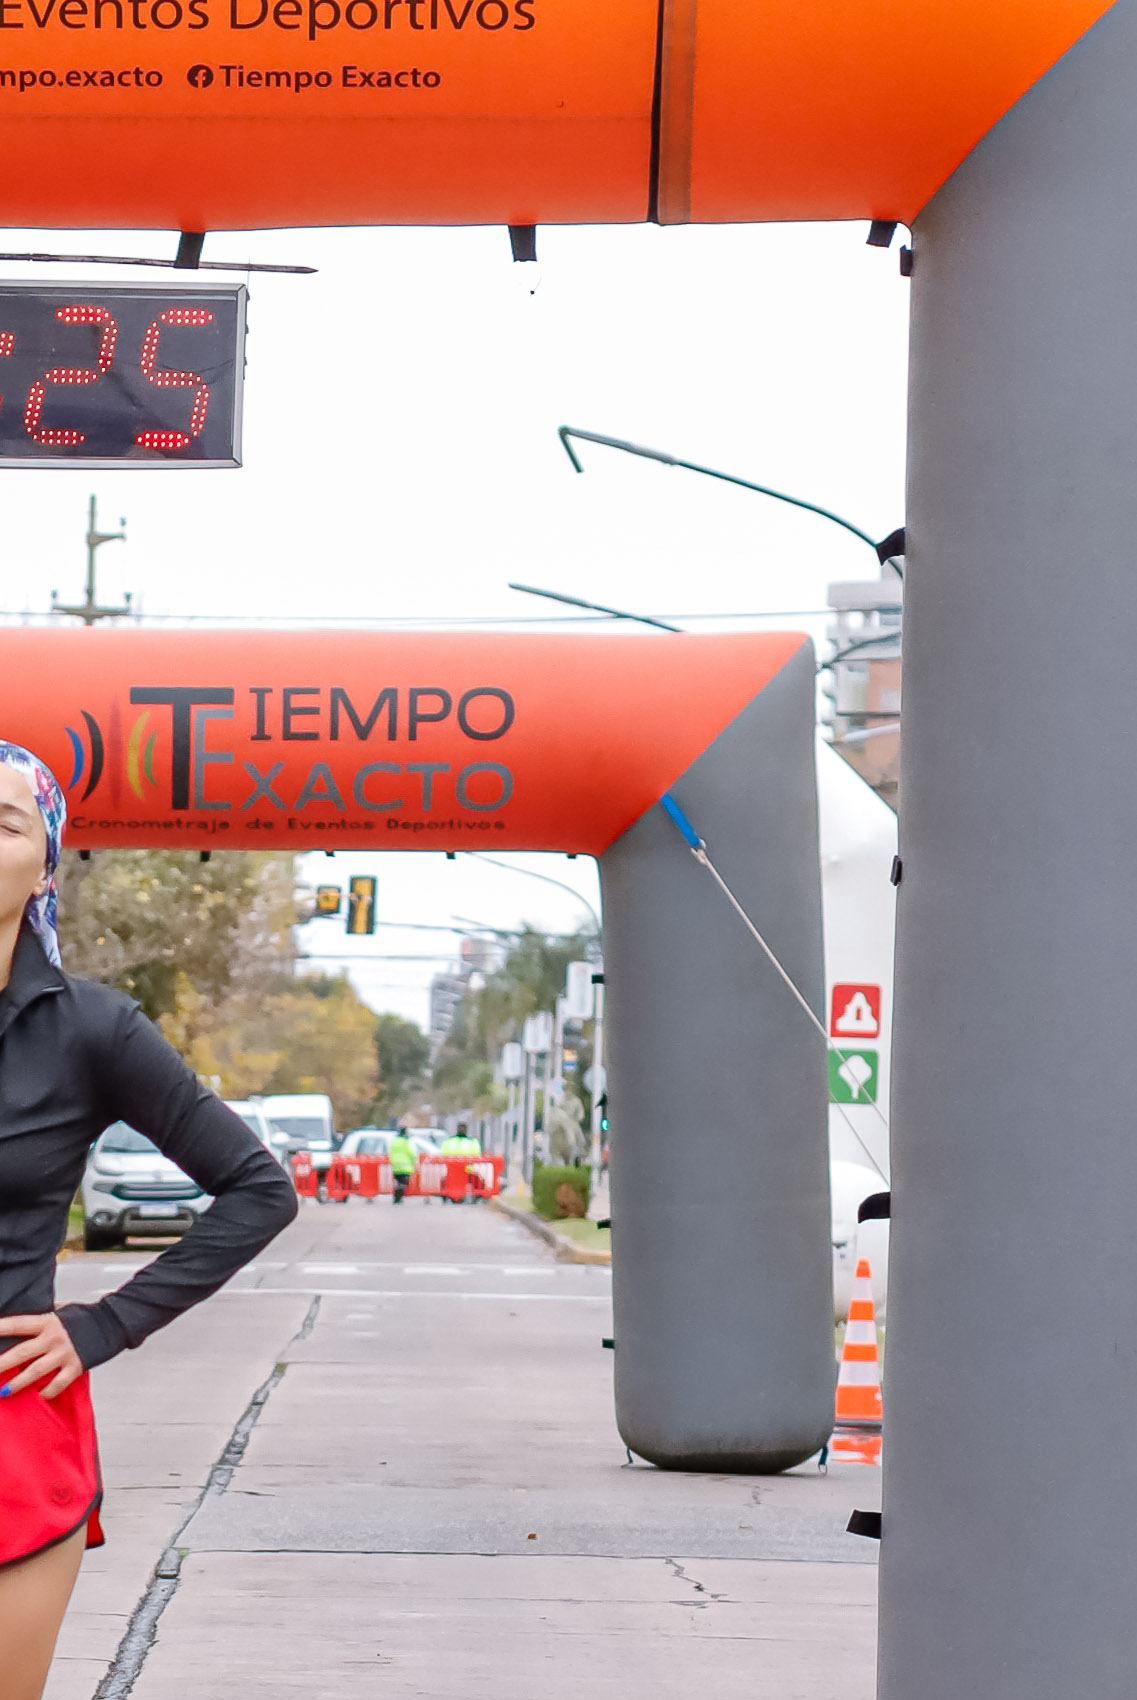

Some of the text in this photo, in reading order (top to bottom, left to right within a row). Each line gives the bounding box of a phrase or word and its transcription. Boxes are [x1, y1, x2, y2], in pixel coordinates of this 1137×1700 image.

[229, 0, 536, 41] Deportivos
[220, 65, 333, 93] Tiempo
[342, 66, 442, 90] Exacto
[70, 816, 506, 834] Cronometraje de Eventos Deportivos
